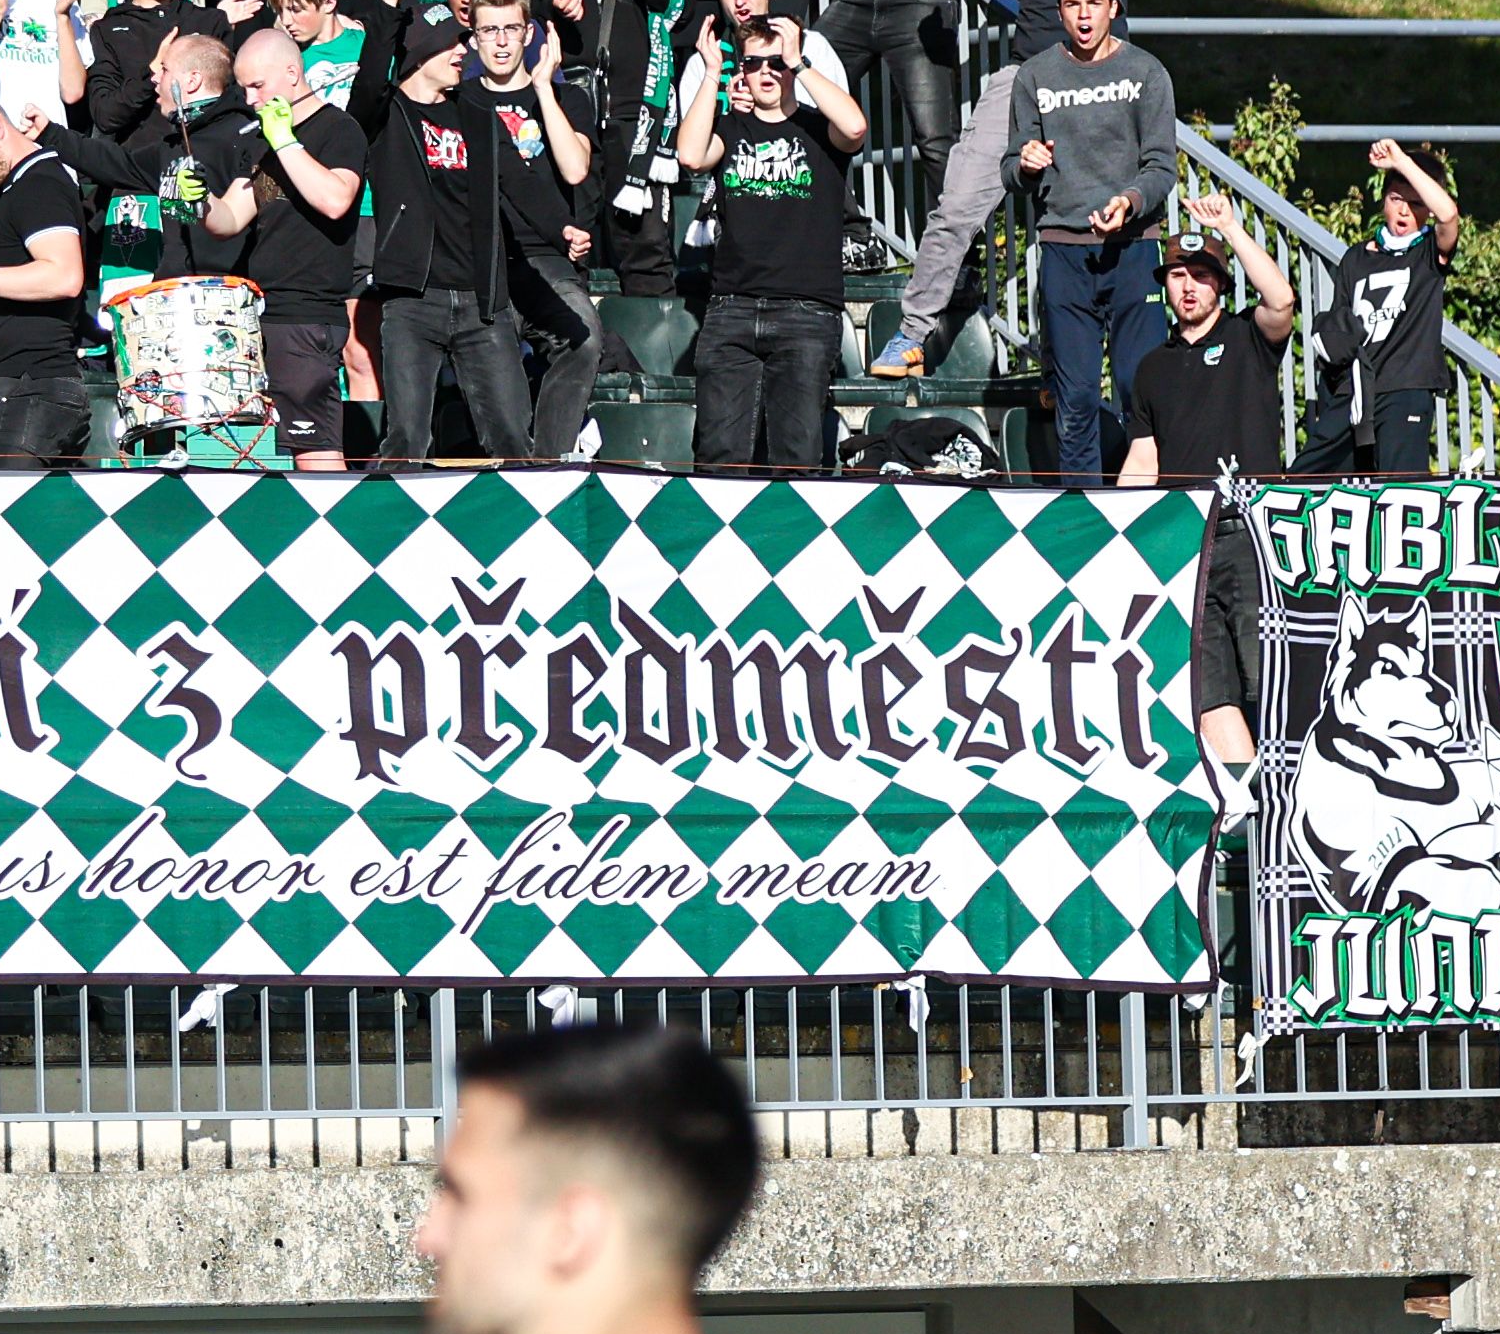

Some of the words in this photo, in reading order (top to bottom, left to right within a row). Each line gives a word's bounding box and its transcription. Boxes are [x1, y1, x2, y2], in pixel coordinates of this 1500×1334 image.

[1056, 79, 1142, 105] meatfly
[145, 627, 226, 781] z
[332, 572, 1162, 783] předměstí
[88, 805, 325, 897] honor
[350, 835, 468, 899] est
[458, 810, 708, 935] fidem
[718, 855, 938, 901] meam
